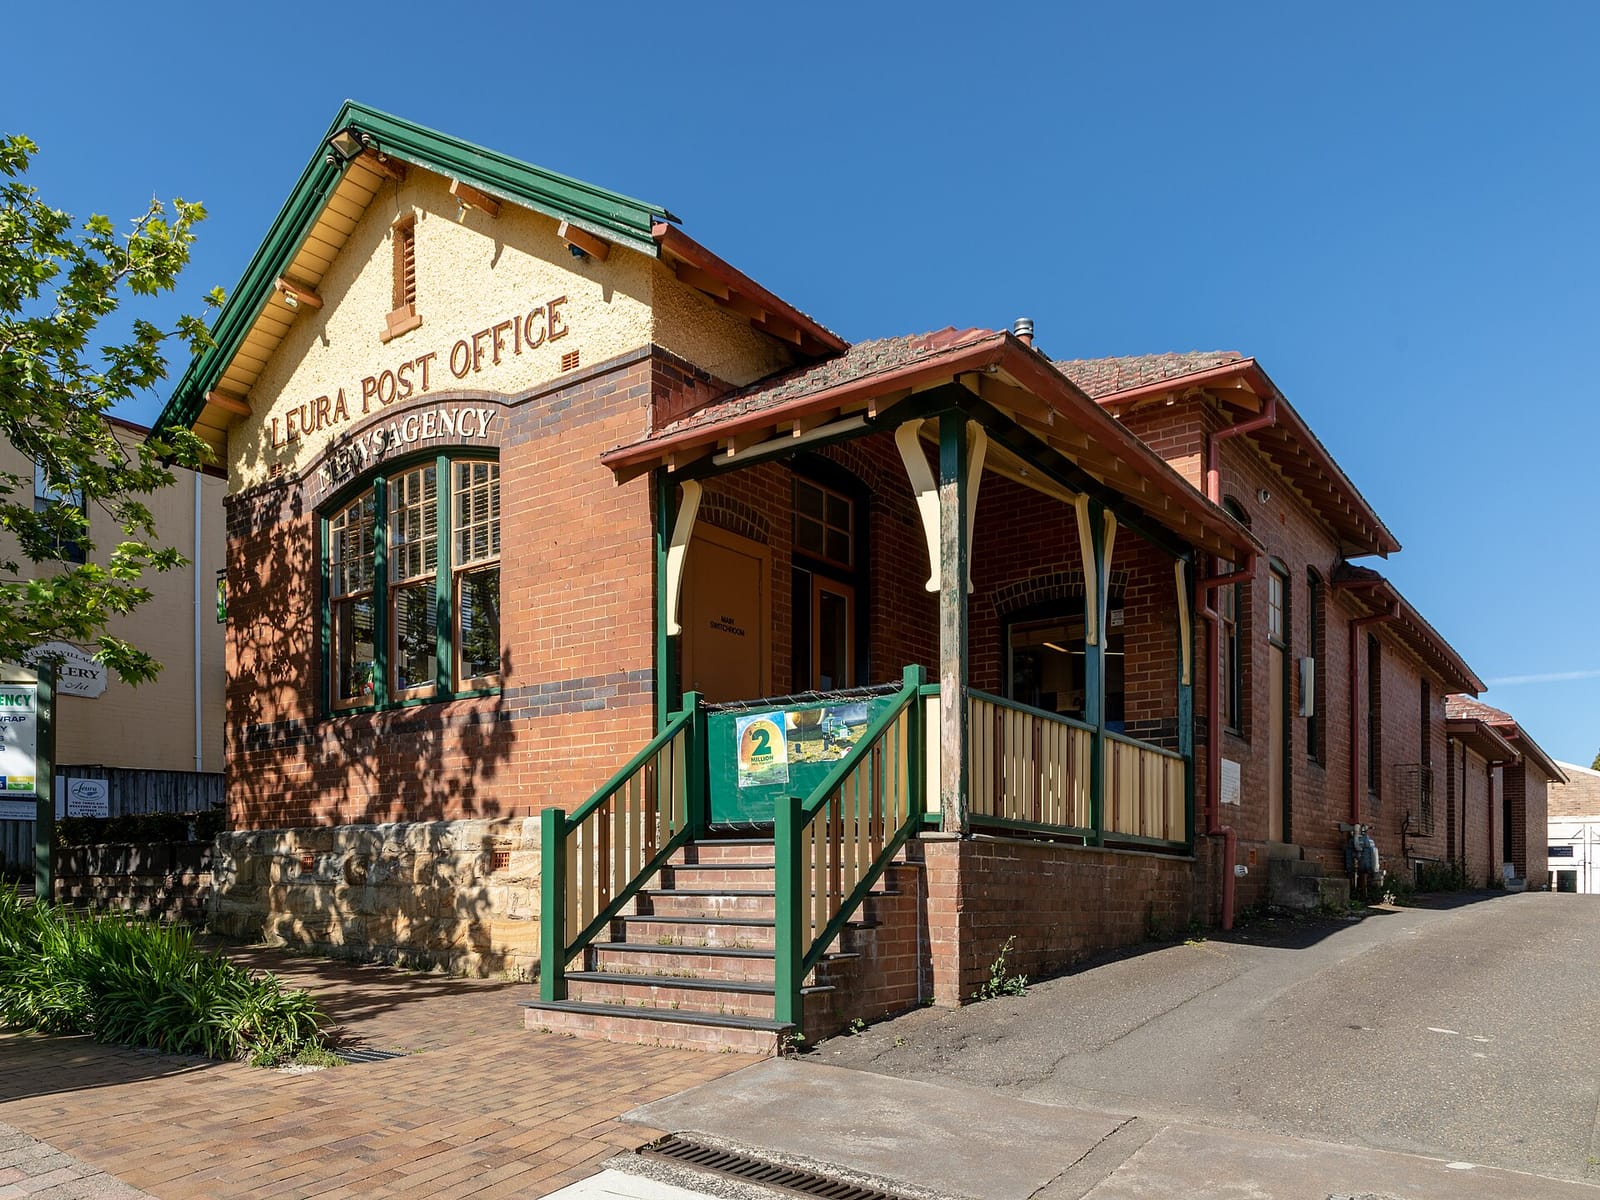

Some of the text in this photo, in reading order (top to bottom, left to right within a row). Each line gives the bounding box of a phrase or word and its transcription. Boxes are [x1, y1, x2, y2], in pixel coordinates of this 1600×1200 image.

[271, 296, 569, 449] LEURA POST OFFICE
[318, 407, 495, 494] NEWSAGENCY
[751, 755, 773, 763] MILLION
